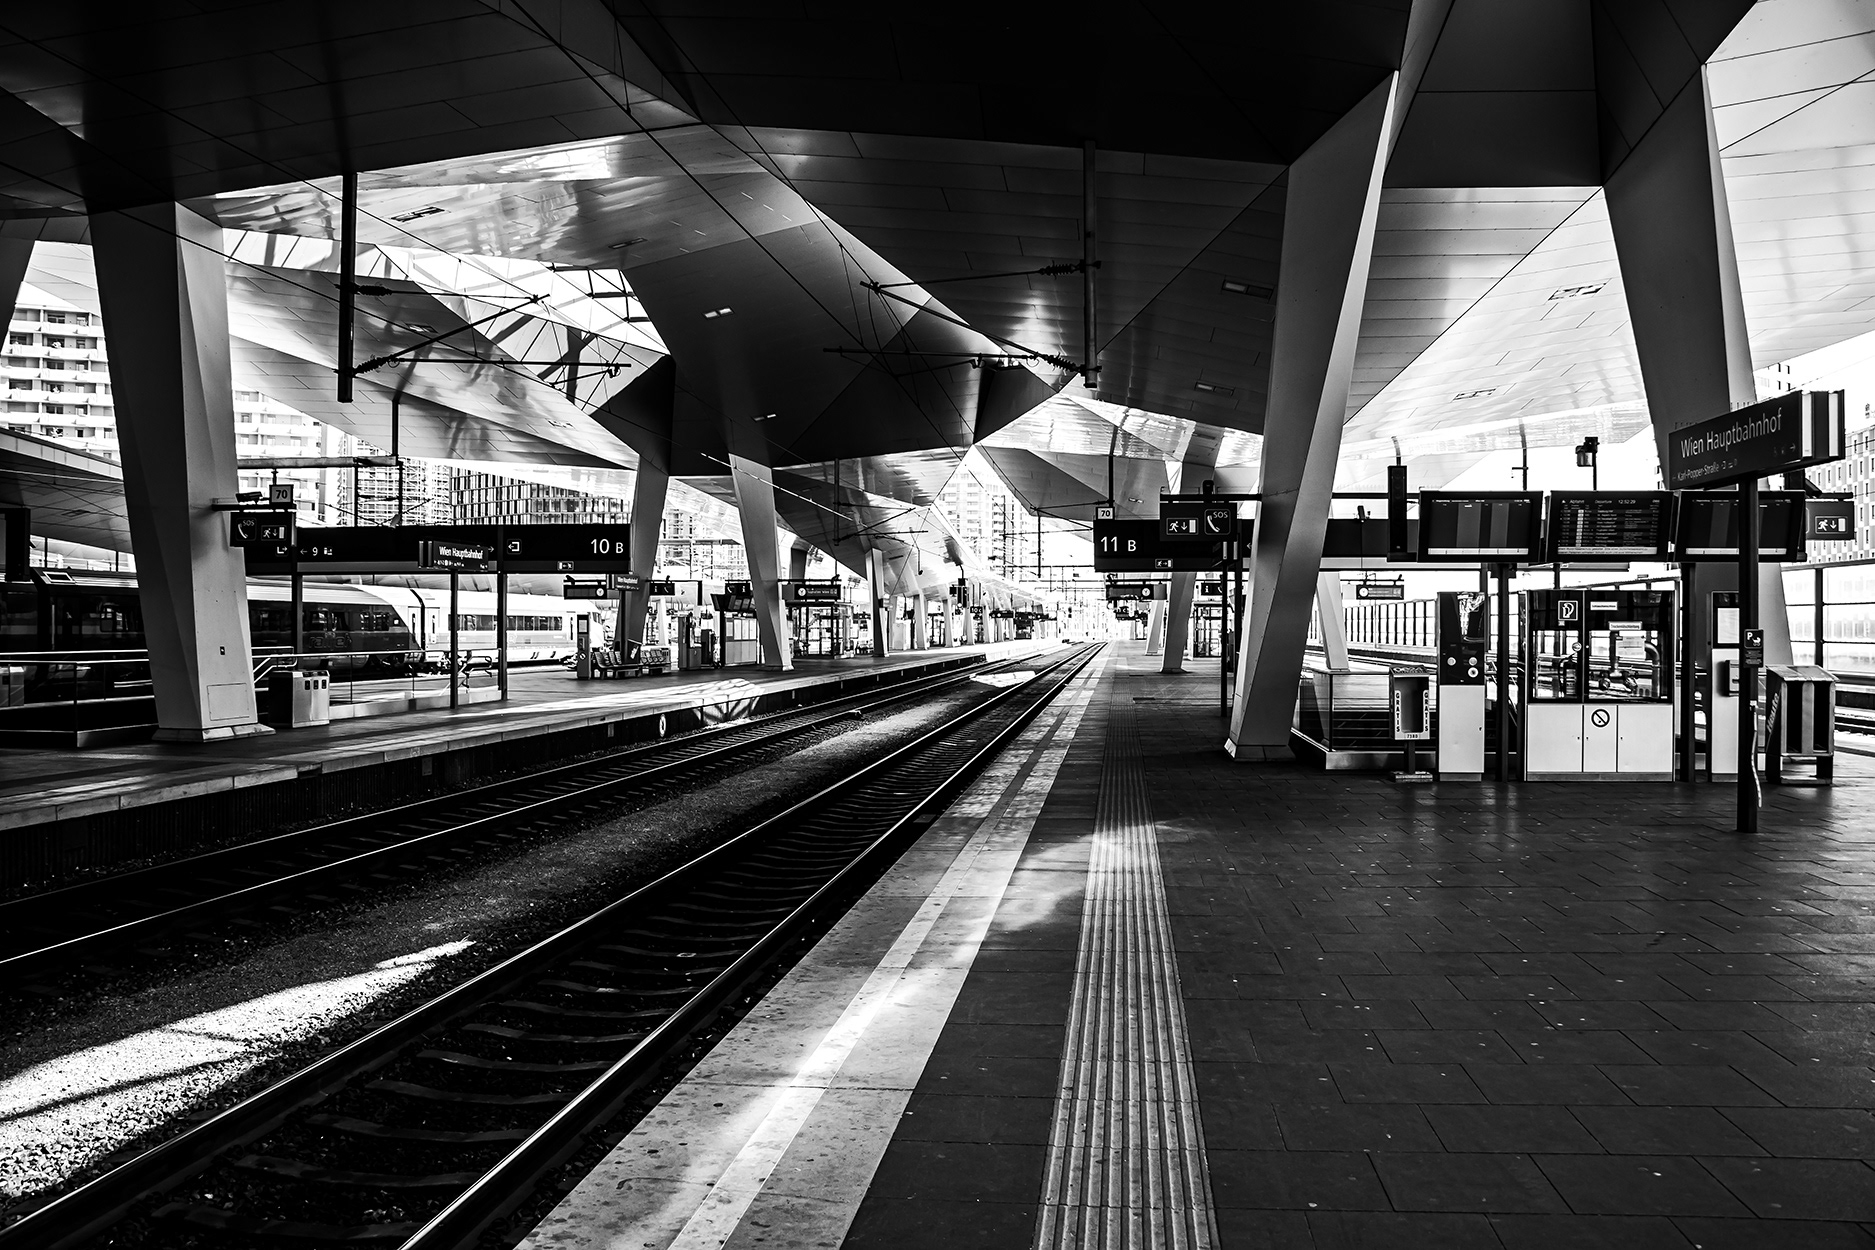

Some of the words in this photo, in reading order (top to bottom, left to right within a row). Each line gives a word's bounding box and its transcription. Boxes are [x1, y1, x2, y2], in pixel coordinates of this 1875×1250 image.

[1681, 437, 1704, 458] Wien
[1706, 407, 1782, 451] Hauptbahnhof
[275, 490, 288, 500] 70
[591, 539, 609, 554] 10
[616, 542, 624, 554] B
[1101, 536, 1117, 552] 11
[1128, 540, 1136, 552] B
[312, 547, 318, 556] 9
[439, 546, 451, 556] Wien
[452, 548, 483, 560] Hauptbahnhof
[1747, 632, 1753, 640] P
